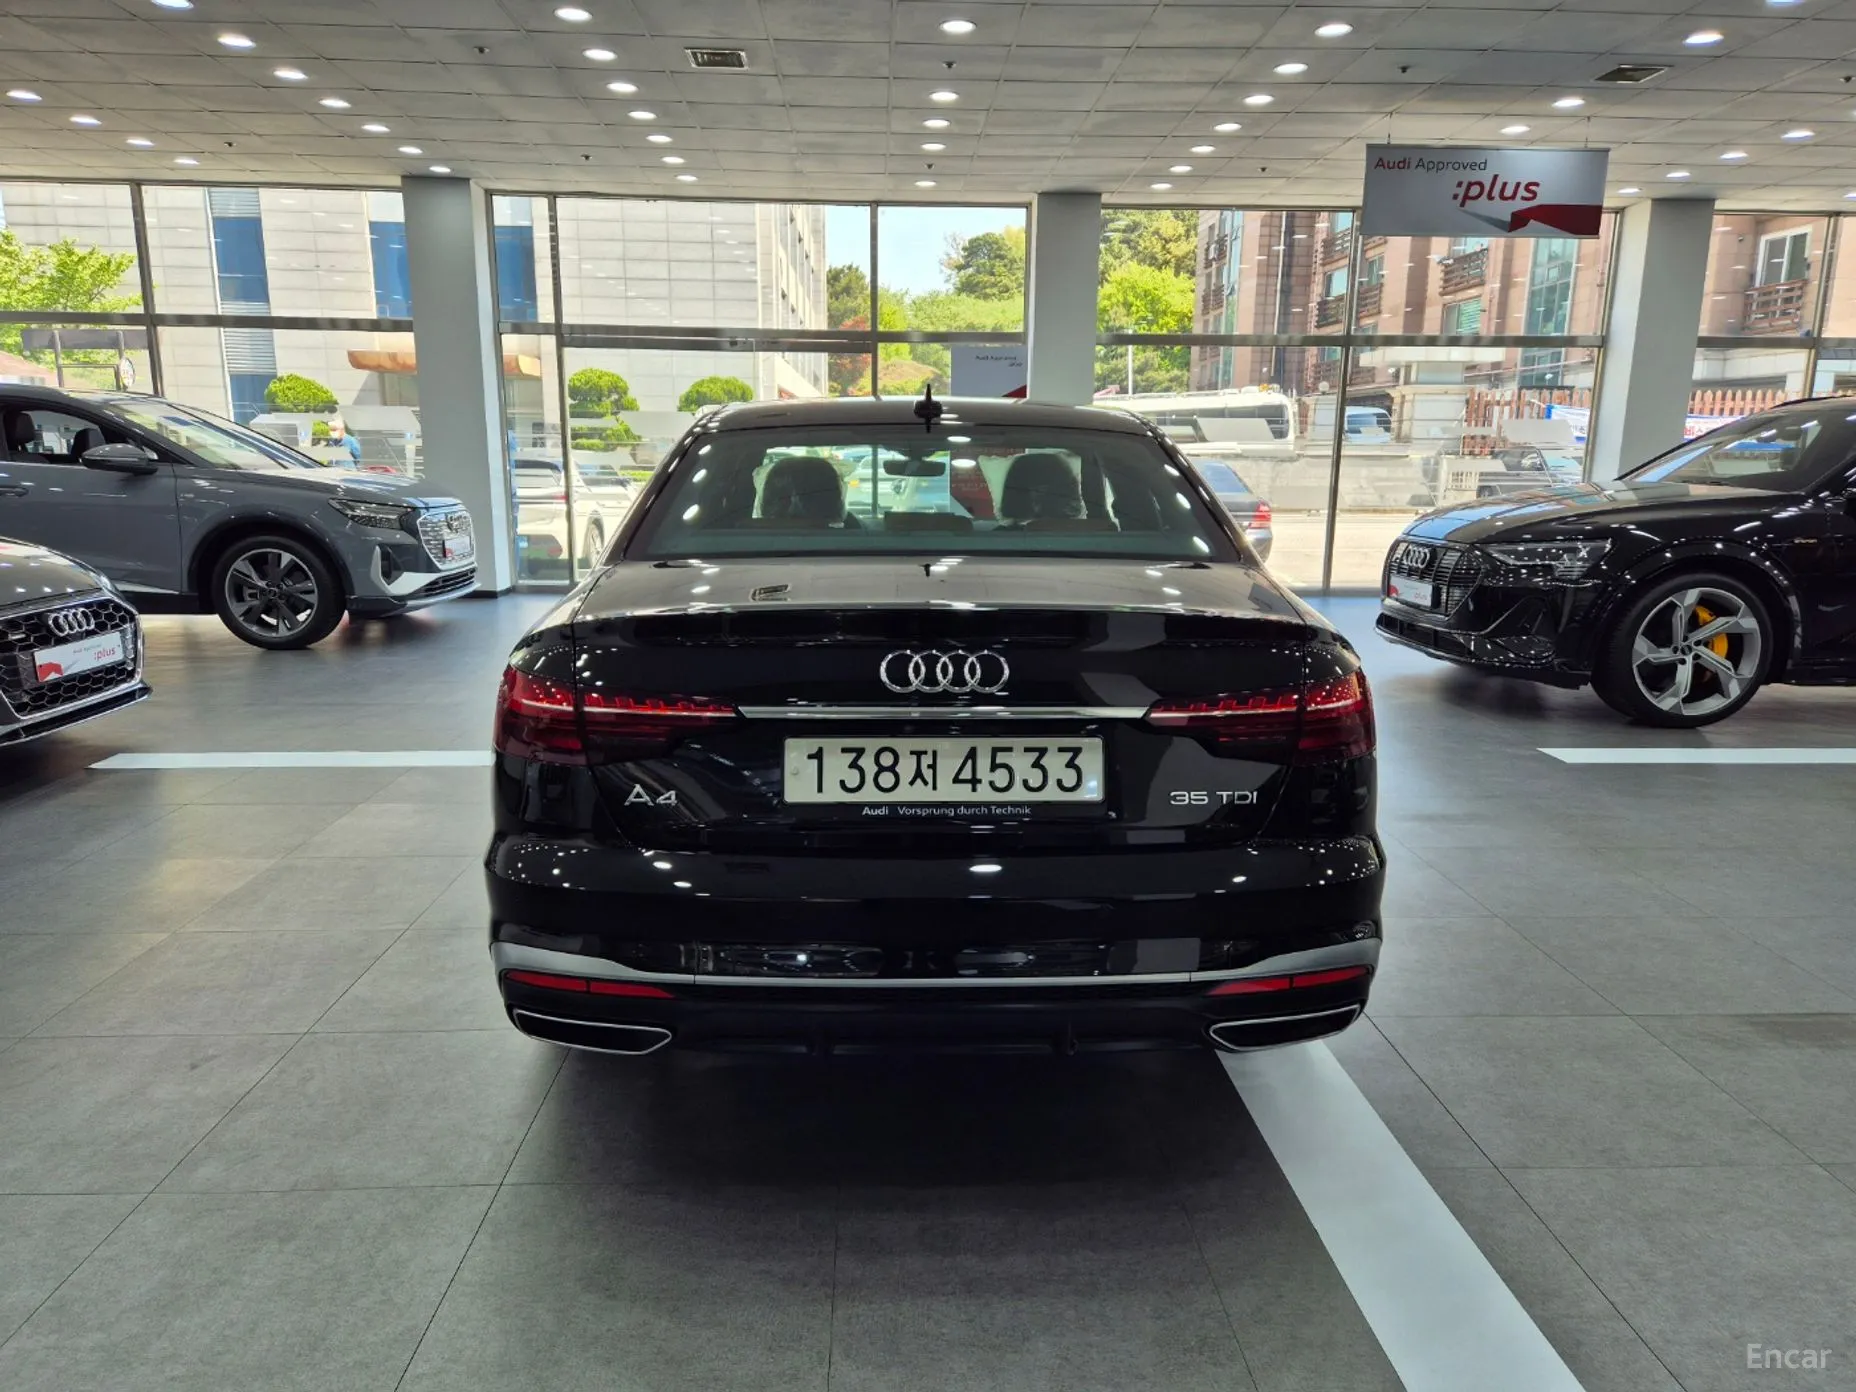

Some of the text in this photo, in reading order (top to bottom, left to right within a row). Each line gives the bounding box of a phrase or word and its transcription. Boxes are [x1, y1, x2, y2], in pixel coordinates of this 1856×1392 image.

[1374, 157, 1488, 174] Audi Approved
[624, 783, 678, 807] A4
[1169, 790, 1258, 805] 35 TDI
[861, 804, 1032, 817] Audi Vorsprung durch Technik
